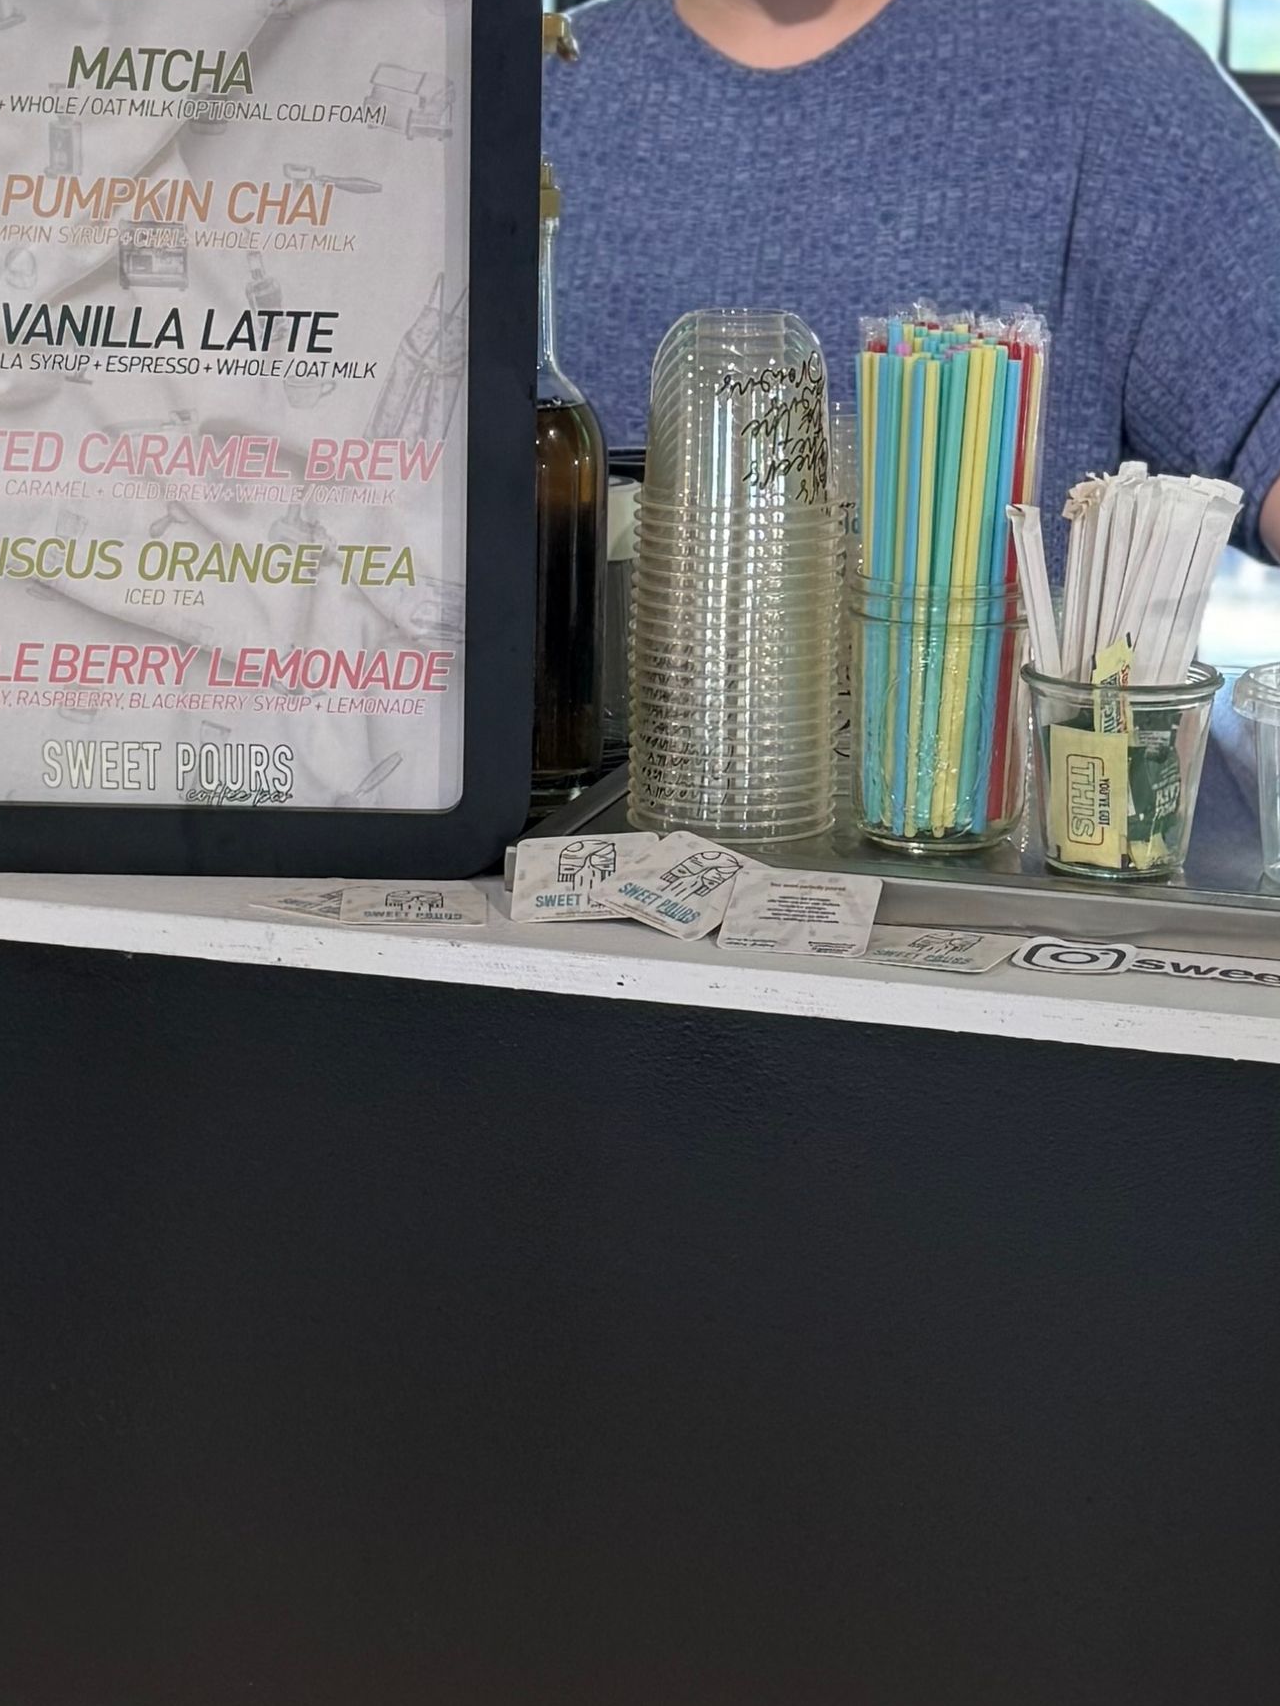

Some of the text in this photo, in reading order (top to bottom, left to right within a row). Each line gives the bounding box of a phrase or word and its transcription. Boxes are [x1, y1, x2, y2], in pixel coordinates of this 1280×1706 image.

[67, 45, 253, 95] MATCHA
[128, 98, 175, 118] MILK
[177, 99, 273, 122] (OPTIONAL
[276, 103, 325, 123] COLD
[328, 105, 387, 126] FOAM)
[1, 173, 334, 226] PUMPKIN CHAI
[57, 225, 119, 245] SYRUP
[134, 228, 181, 249] CHAI
[310, 234, 358, 252] MILK
[2, 302, 339, 354] VANILLA LATTE
[29, 353, 90, 372] SYRUP
[105, 356, 201, 375] ESPRESSO
[332, 361, 378, 380] MILK
[78, 431, 292, 479] CARAMEL
[305, 438, 444, 482] BREW
[5, 479, 91, 500] CARAMEL
[111, 481, 160, 501] COLD
[165, 483, 224, 503] BREW
[352, 487, 395, 505] MILK
[138, 541, 323, 584] ORANGE
[337, 545, 416, 586] TEA
[124, 588, 205, 607] ICED TEA
[48, 643, 199, 687] BERRY
[207, 646, 455, 692] LEMONADE
[16, 690, 125, 711] RASPBERRY,
[128, 693, 247, 711] BLACKBERRY
[252, 694, 313, 713] SYRUP
[326, 697, 426, 716] LEMONADE
[42, 740, 294, 793] SWEET POURS
[1070, 761, 1096, 839] THIS
[535, 893, 582, 908] SWEET
[618, 882, 660, 905] SWEET
[656, 896, 701, 925] POURS
